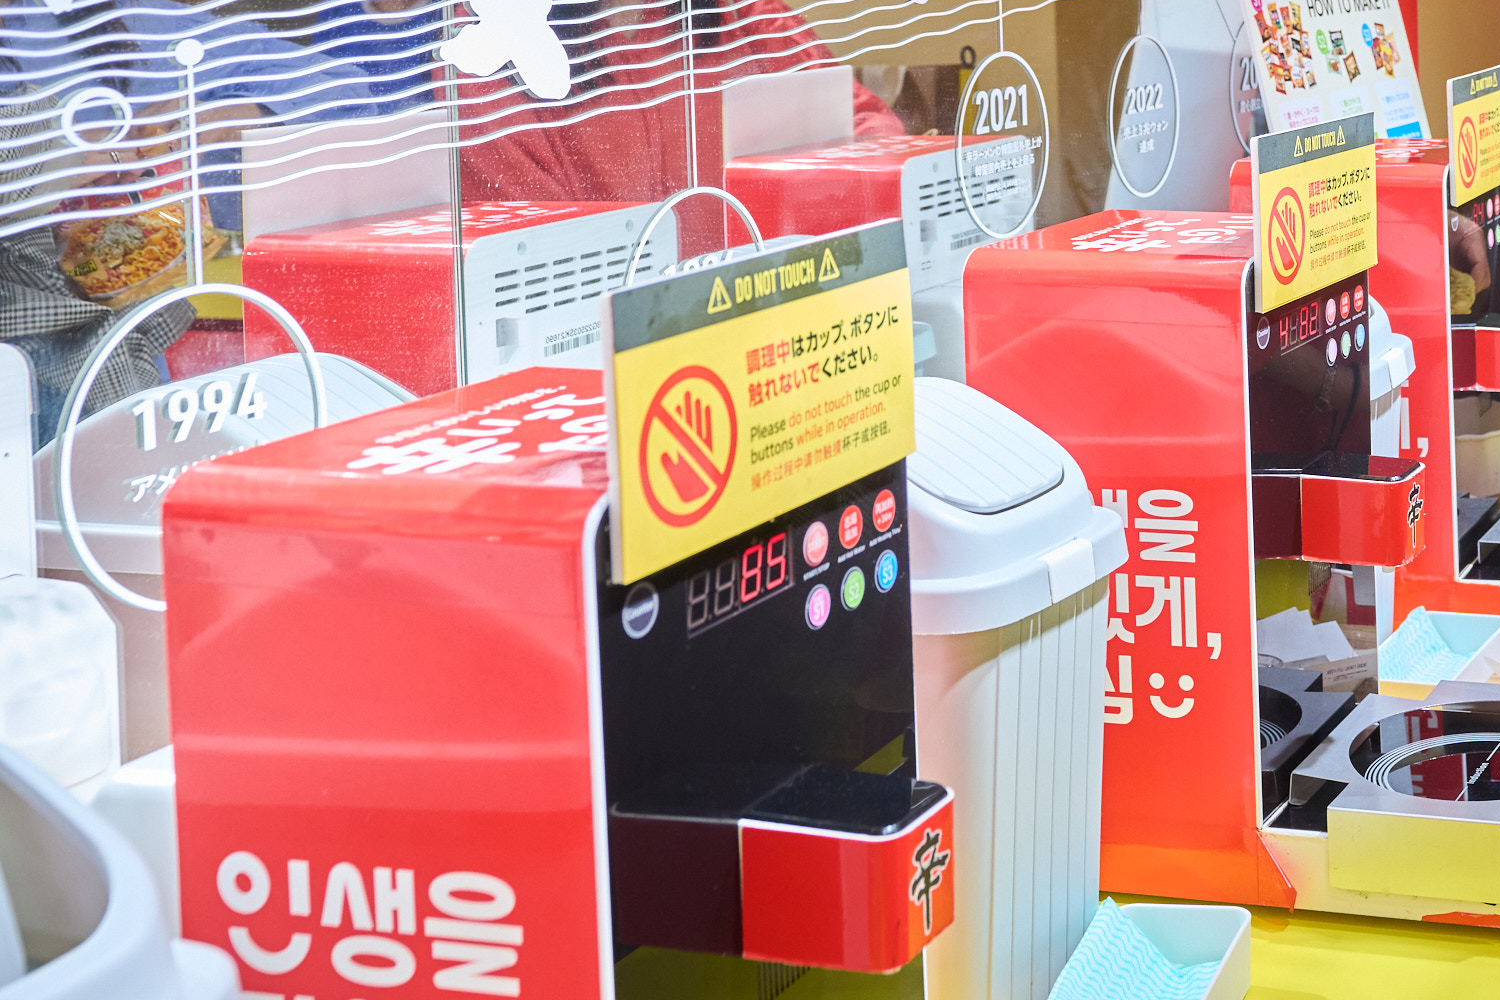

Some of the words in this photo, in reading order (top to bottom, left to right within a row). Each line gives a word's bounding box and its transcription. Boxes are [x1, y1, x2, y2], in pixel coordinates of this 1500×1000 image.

[973, 84, 1028, 135] 2021
[1127, 83, 1163, 115] 2022
[1304, 136, 1312, 153] DO
[1312, 134, 1321, 151] NOT
[1322, 131, 1336, 148] TOUCH
[1308, 167, 1370, 198] 調理中はカップ、ボタンに
[1309, 190, 1362, 218] 触れないでください。
[1310, 226, 1324, 240] Please
[1351, 214, 1359, 226] the
[1310, 239, 1327, 254] buttons
[735, 276, 753, 304] DO
[754, 268, 777, 299] NOT
[778, 258, 816, 290] TOUCH
[745, 305, 899, 375] 調理中はカップ、ボタンに
[748, 346, 879, 408] 触れないでください。
[127, 372, 268, 452] 1994
[750, 418, 786, 443] Please
[788, 411, 802, 429] do
[804, 403, 822, 420] not
[824, 391, 853, 414] touch
[854, 385, 871, 402] the
[872, 376, 890, 395] cup
[892, 373, 902, 387] or
[750, 437, 794, 465] buttons
[796, 422, 824, 446] while
[825, 418, 835, 434] in
[837, 401, 887, 434] operation.
[740, 532, 789, 603] 85
[909, 827, 951, 937] 辛
[216, 850, 525, 998] 인생을
